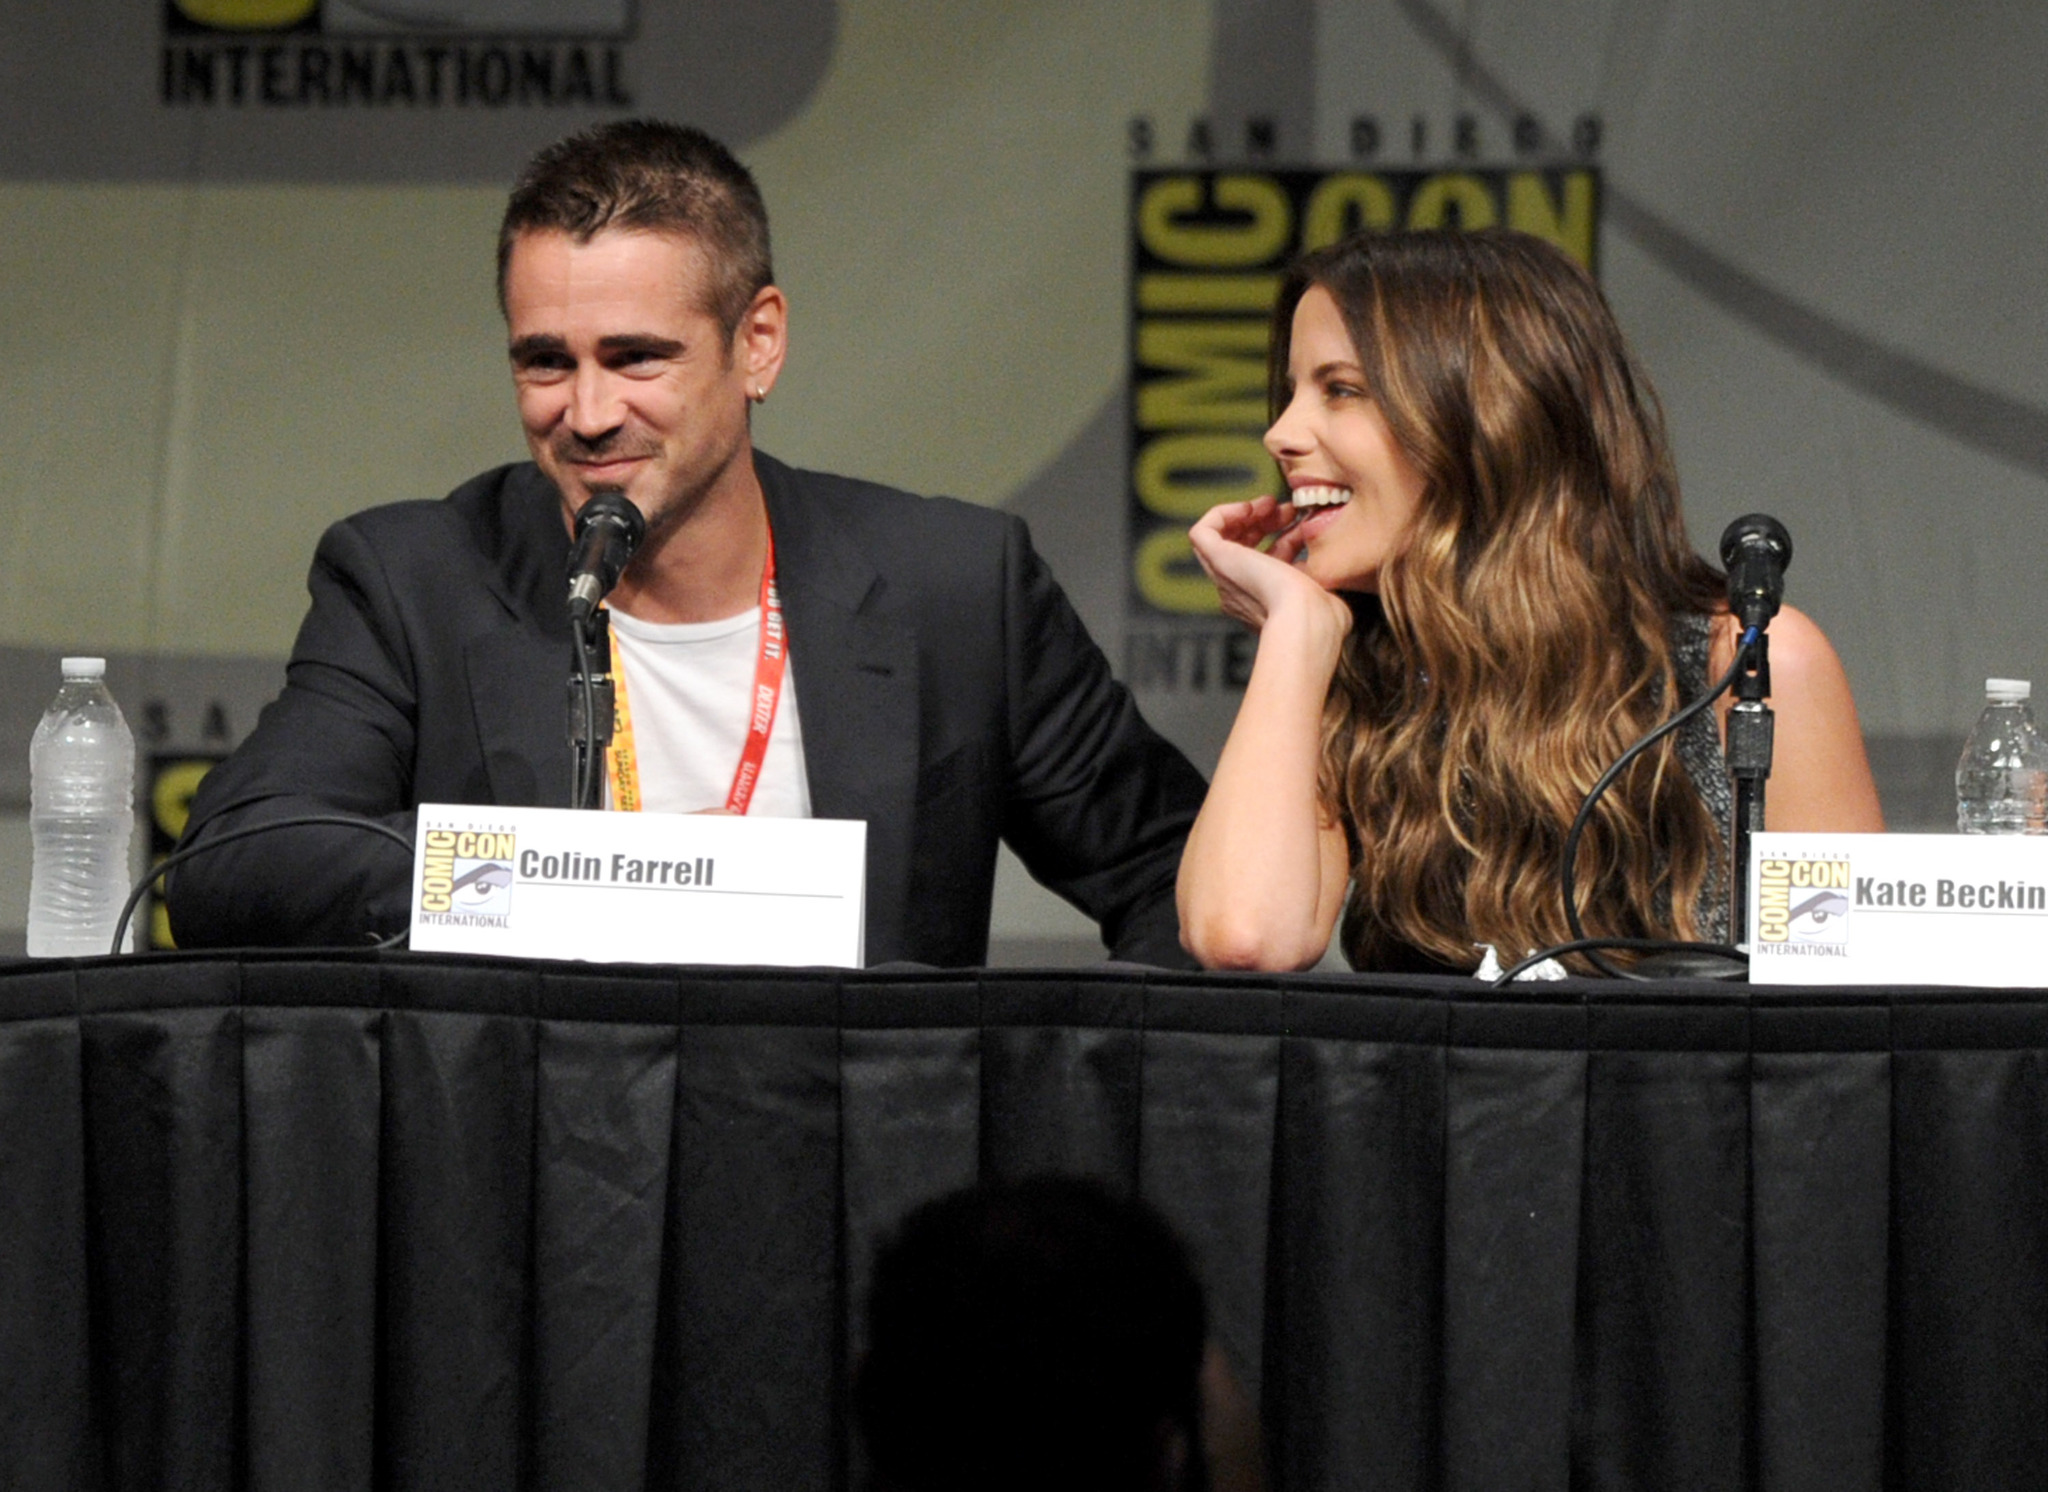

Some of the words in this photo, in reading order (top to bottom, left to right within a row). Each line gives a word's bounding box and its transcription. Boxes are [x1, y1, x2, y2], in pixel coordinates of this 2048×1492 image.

[163, 46, 634, 104] INTERNATIONAL
[1129, 119, 1276, 151] SAN
[767, 611, 783, 640] GET
[752, 685, 774, 734] DEXTER
[426, 821, 454, 829] SAN
[468, 823, 516, 832] DIEGO
[457, 831, 515, 860] CON
[422, 831, 456, 912] COMIC
[519, 850, 601, 881] Colin
[611, 853, 714, 886] Farrell
[1792, 861, 1849, 888] CON
[1759, 860, 1791, 942] COMIC
[1856, 877, 1927, 907] Kate
[1936, 879, 2046, 910] Beckin
[419, 913, 510, 928] INTERNATIONAL
[1757, 944, 1848, 957] INTERNATIONAL
